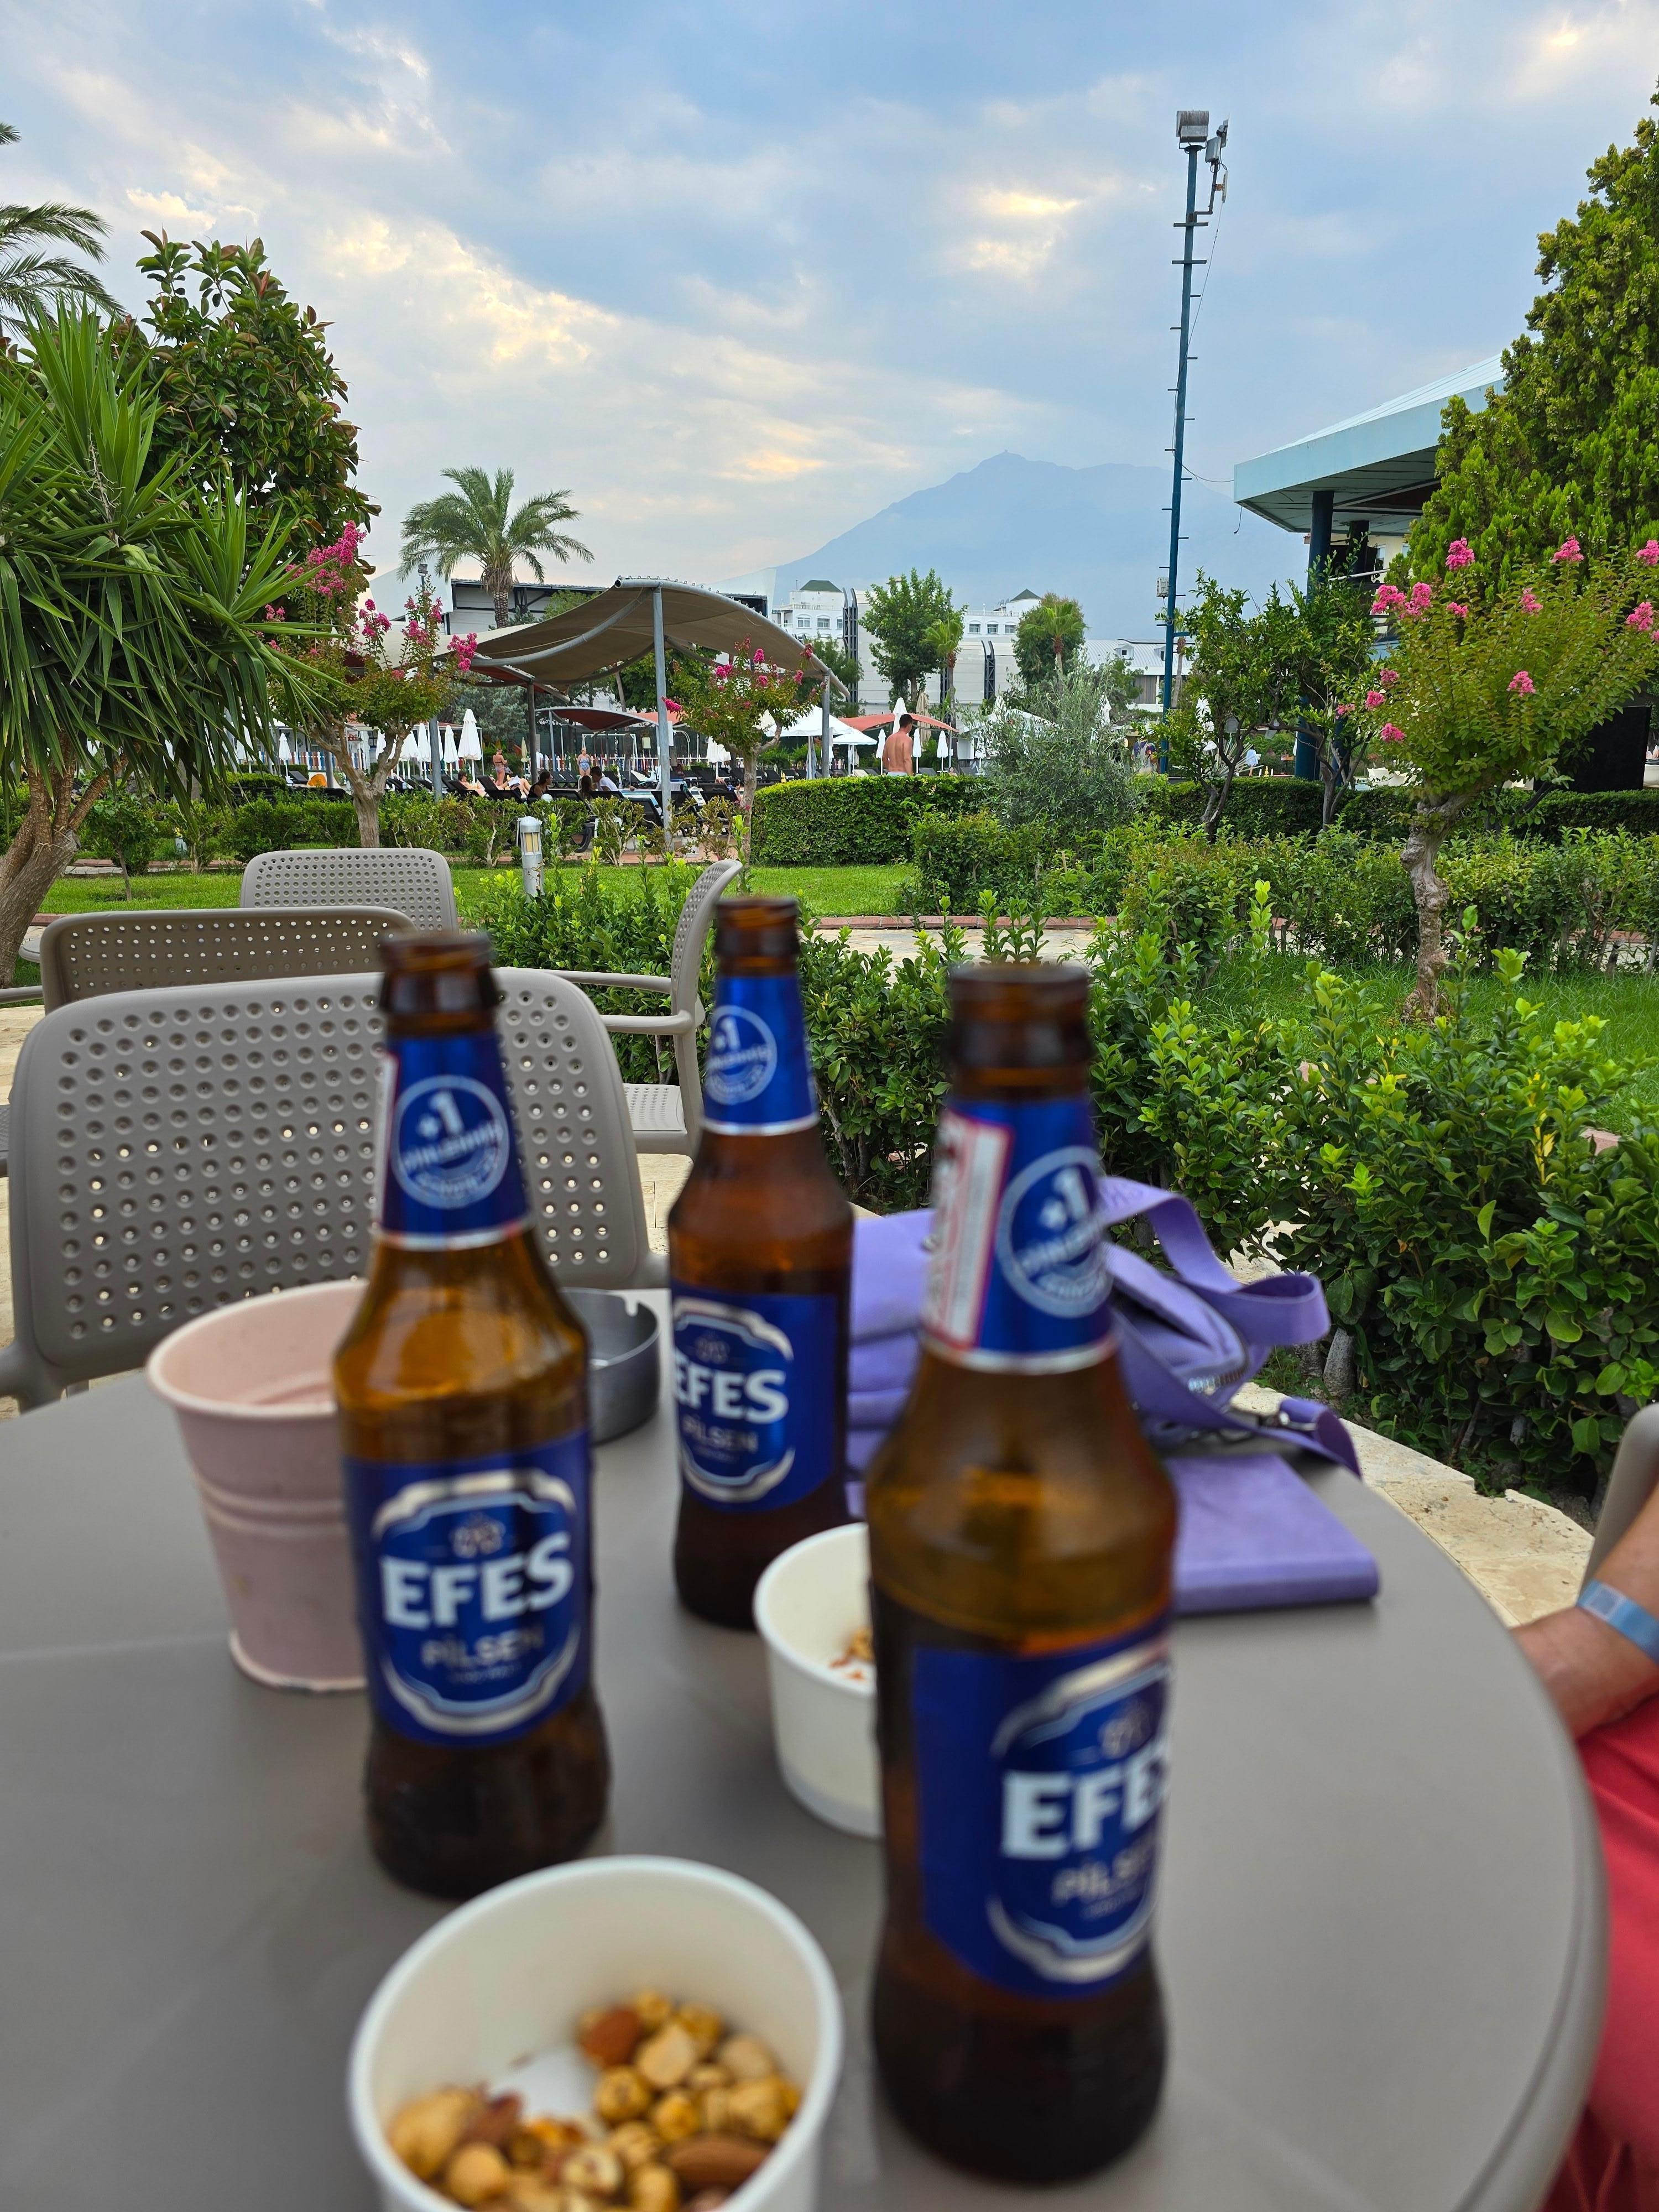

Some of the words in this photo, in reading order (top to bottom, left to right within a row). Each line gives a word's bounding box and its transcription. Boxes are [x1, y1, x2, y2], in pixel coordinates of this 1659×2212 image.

[675, 1349, 789, 1423] EFES
[381, 1531, 573, 1630] EFES
[1001, 1740, 1170, 1860] EFE
